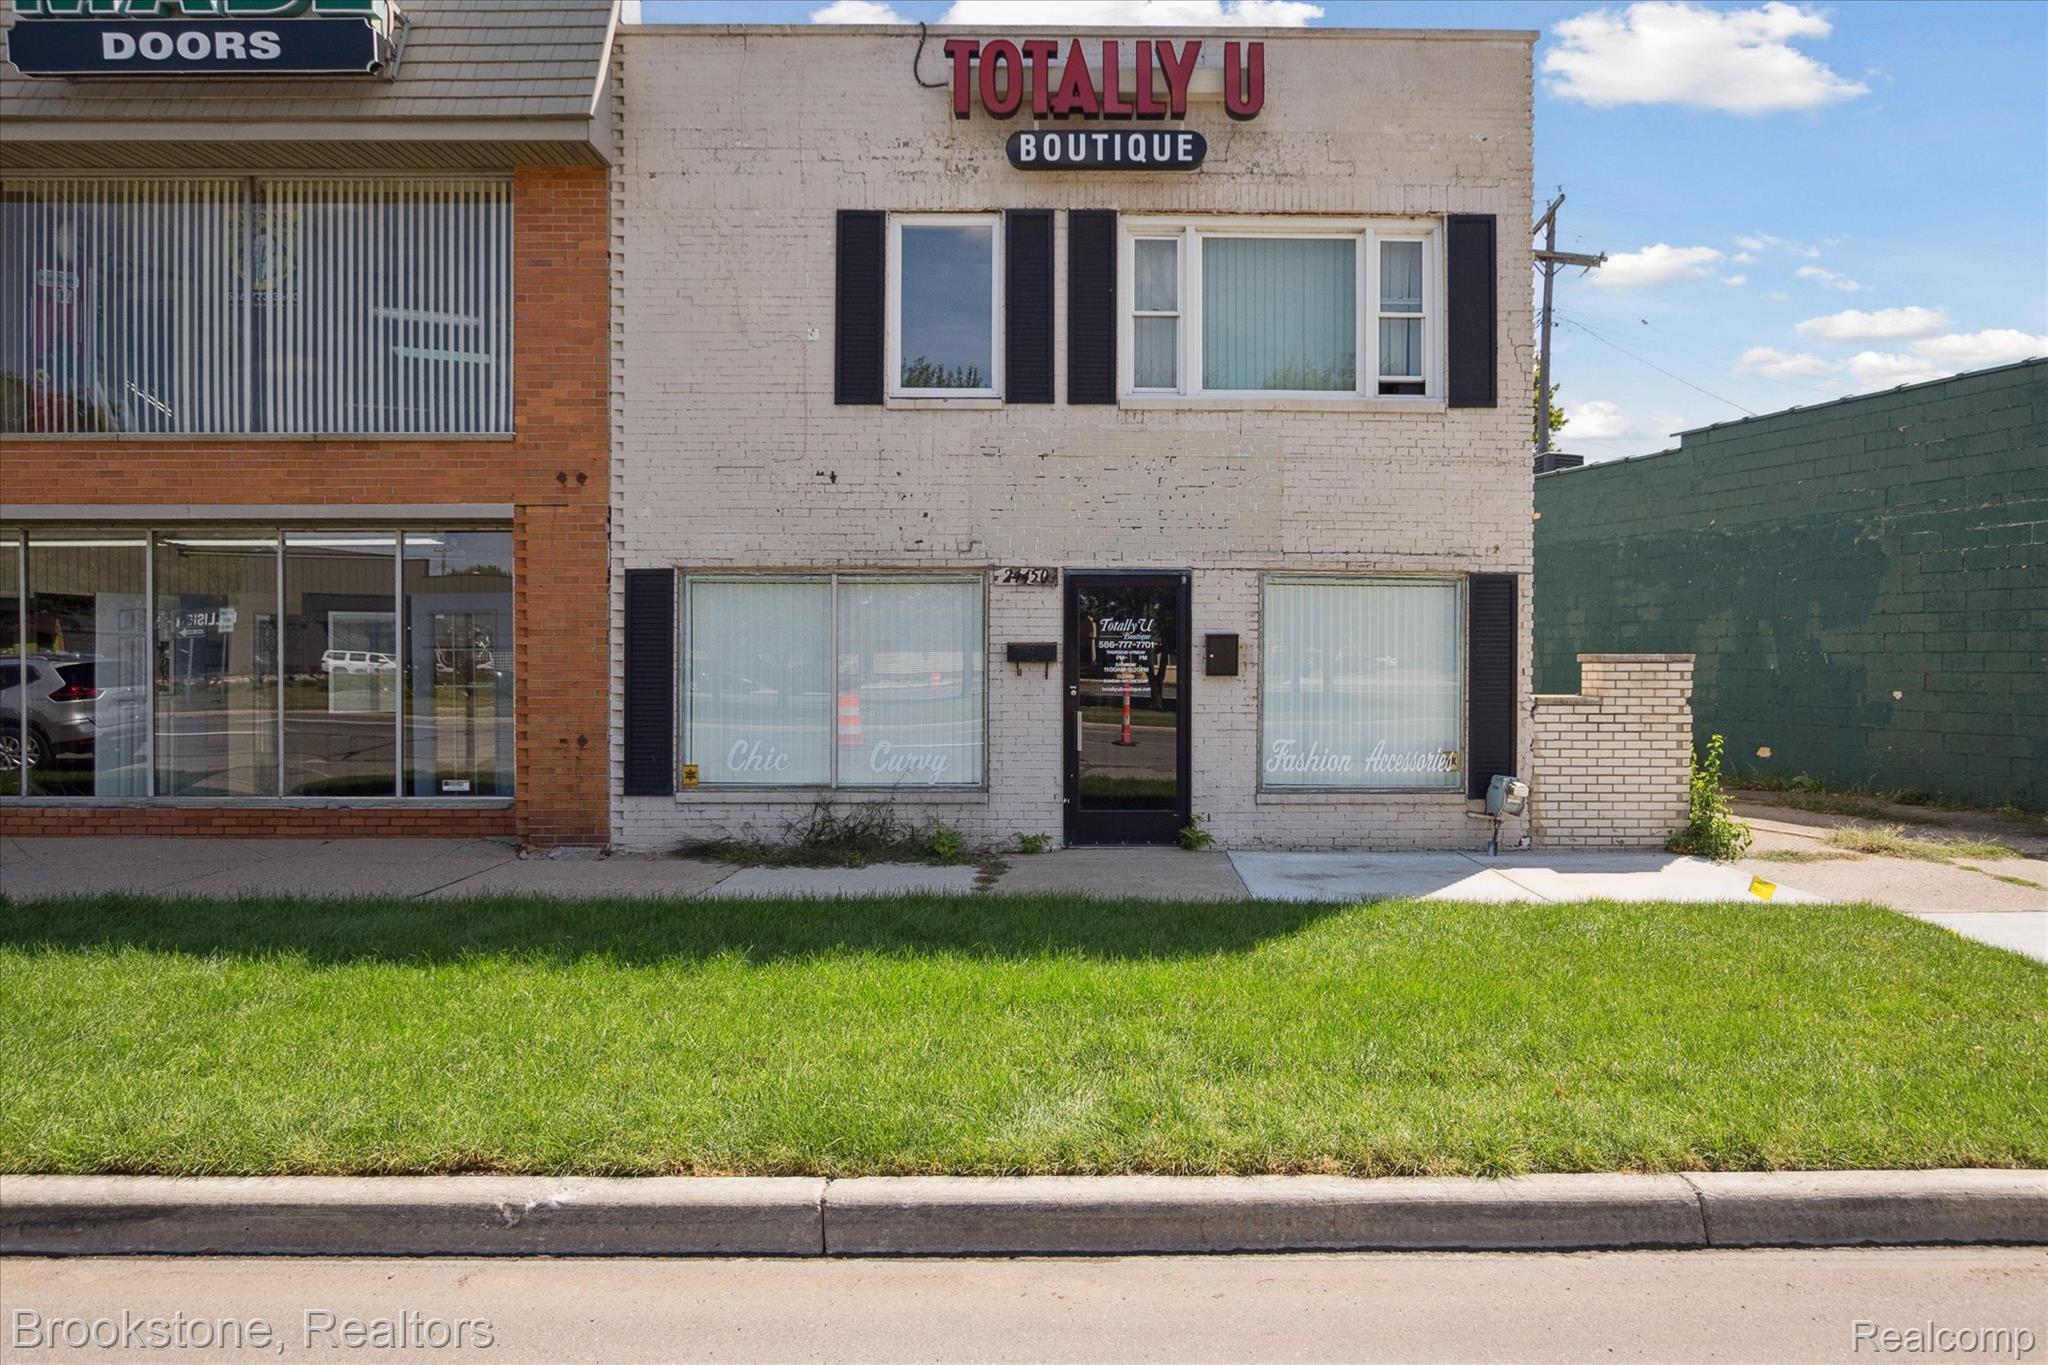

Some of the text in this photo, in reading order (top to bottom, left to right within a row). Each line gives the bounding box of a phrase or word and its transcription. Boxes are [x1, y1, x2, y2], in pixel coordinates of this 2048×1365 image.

[101, 31, 281, 60] DOORS
[943, 38, 1265, 121] TOTALLY U
[1020, 133, 1193, 163] BOUTIQUE
[1100, 617, 1154, 634] Totally U
[1122, 632, 1152, 641] Boutique
[1098, 640, 1155, 649] 586-777-7701
[726, 740, 791, 771] Chic
[870, 740, 951, 785] Curvy
[1266, 739, 1455, 772] Fashion Accessories
